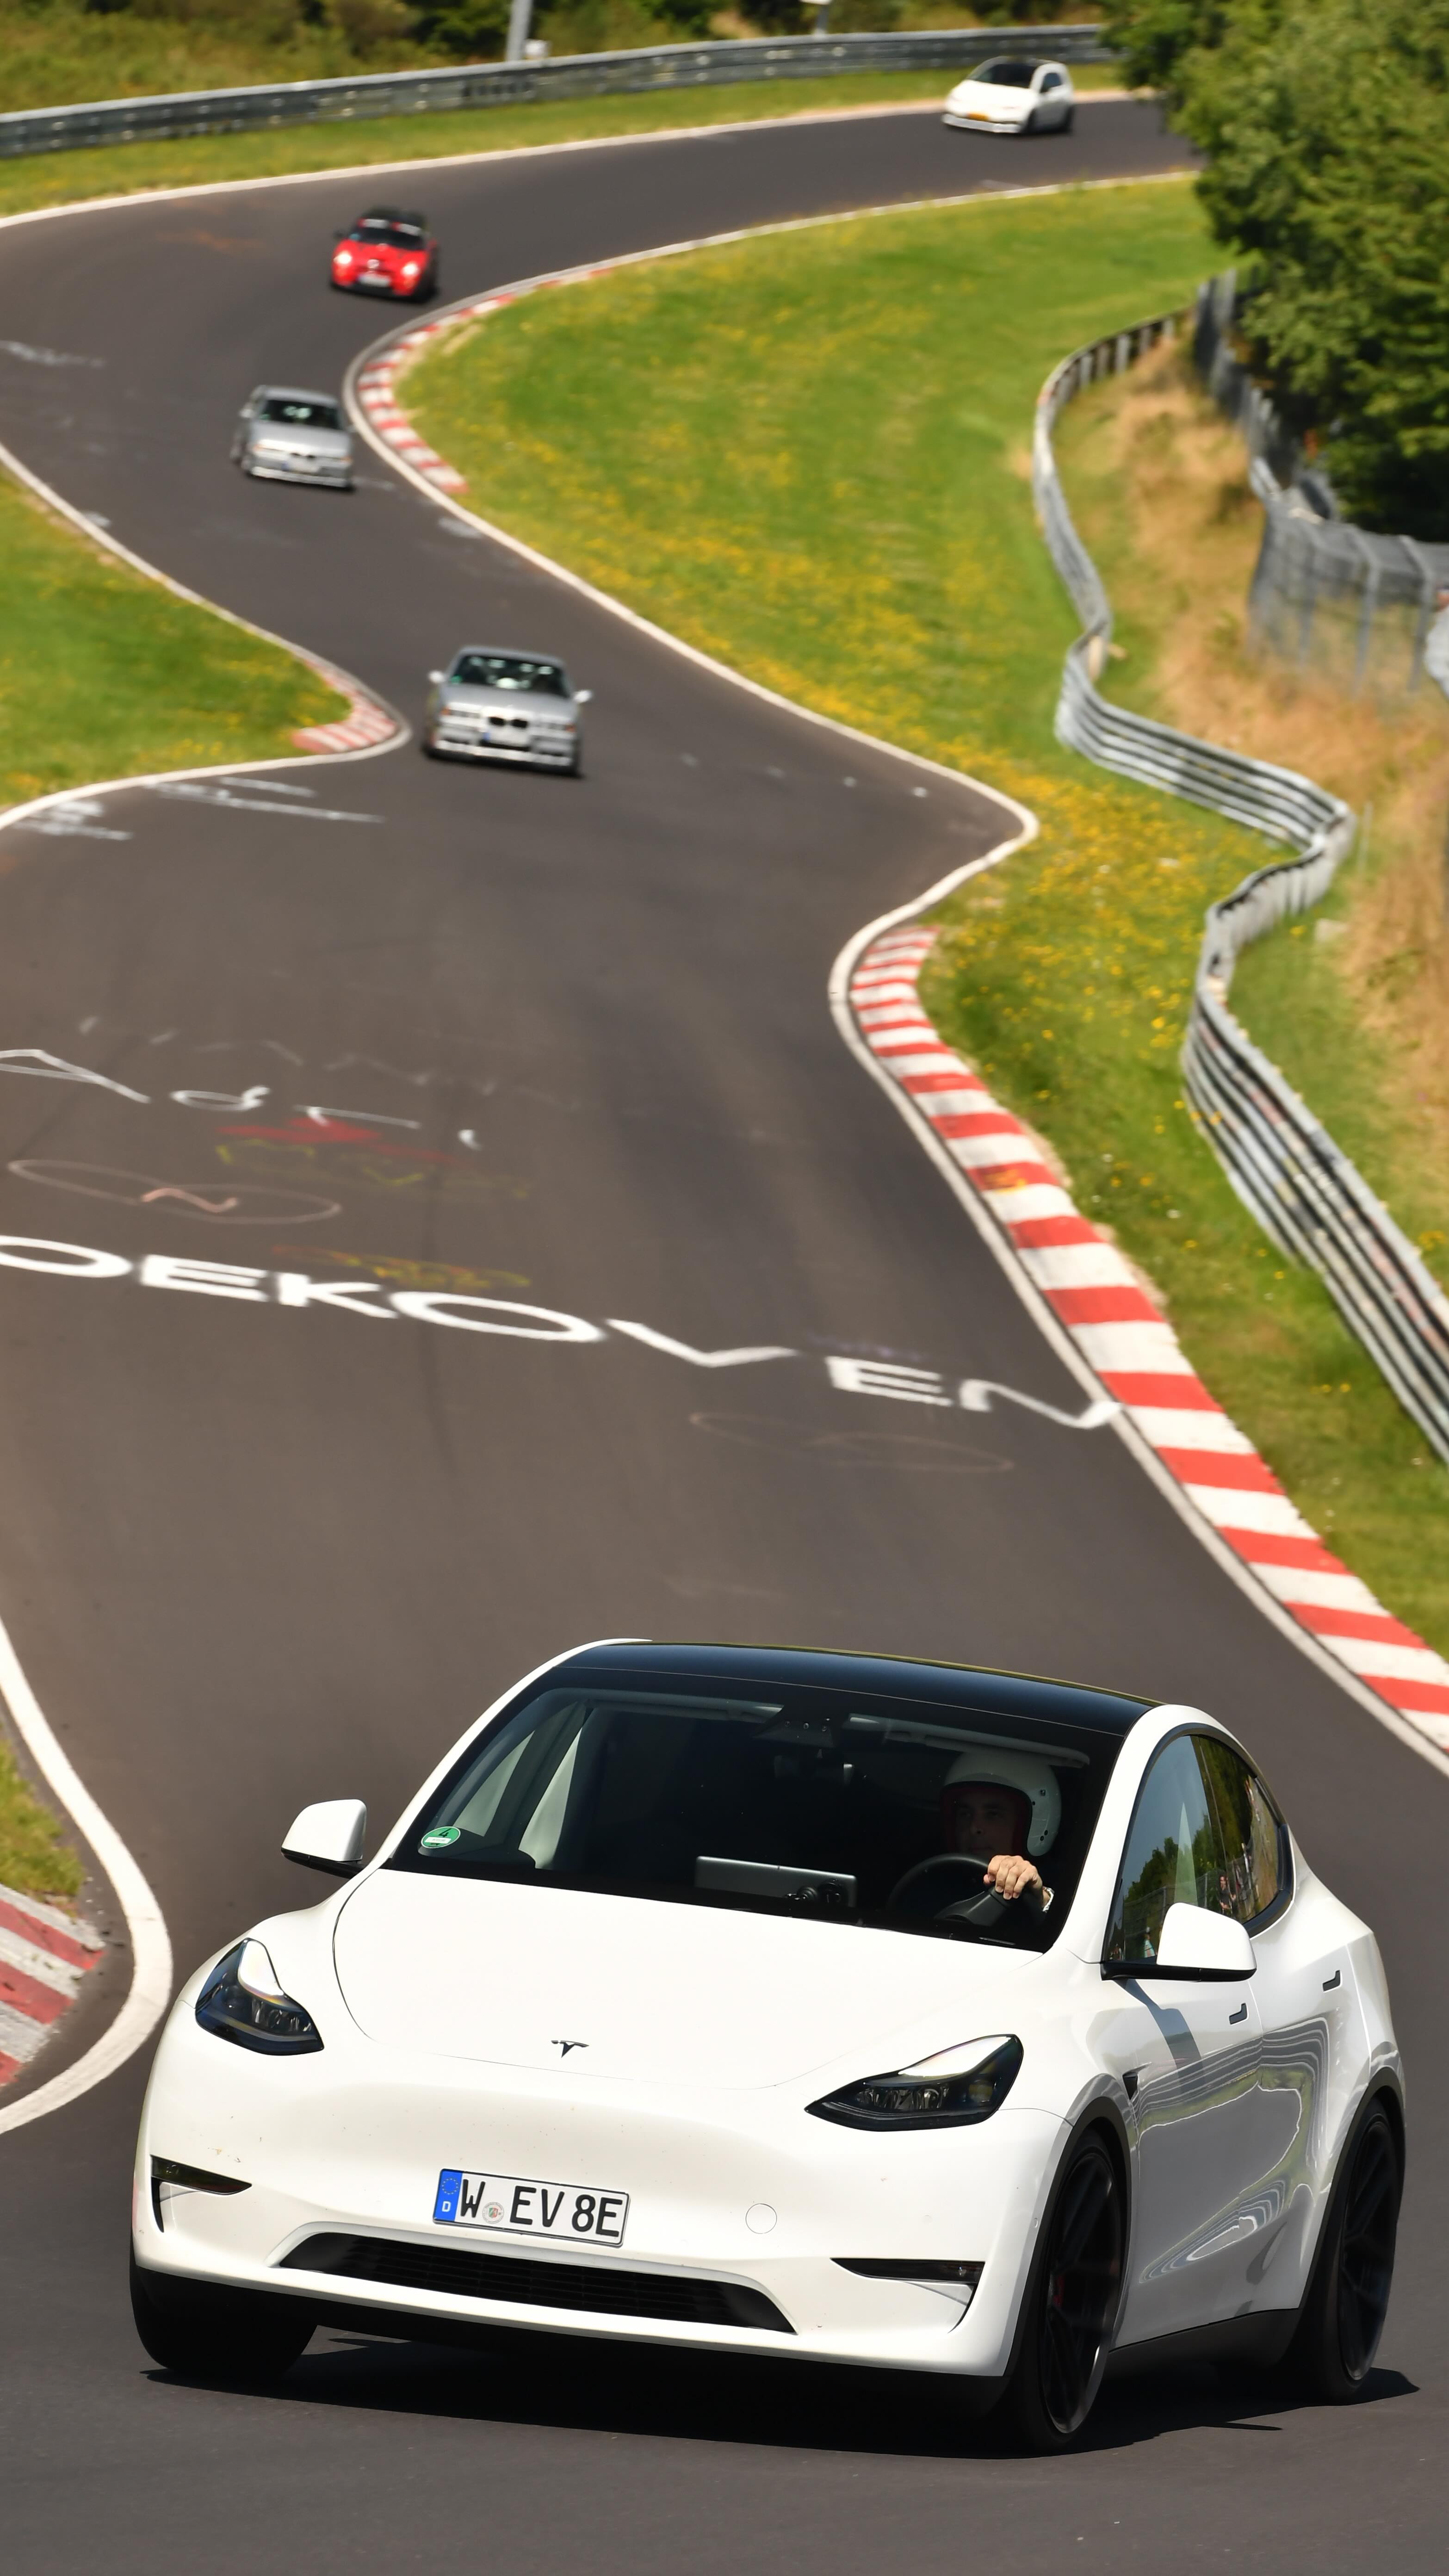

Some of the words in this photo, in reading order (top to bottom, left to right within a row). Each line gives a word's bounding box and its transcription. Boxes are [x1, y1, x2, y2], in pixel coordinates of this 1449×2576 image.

[438, 1828, 452, 1837] 4
[441, 2201, 451, 2212] D
[460, 2179, 486, 2218] W
[510, 2186, 565, 2227] EV
[572, 2194, 623, 2237] 8E
